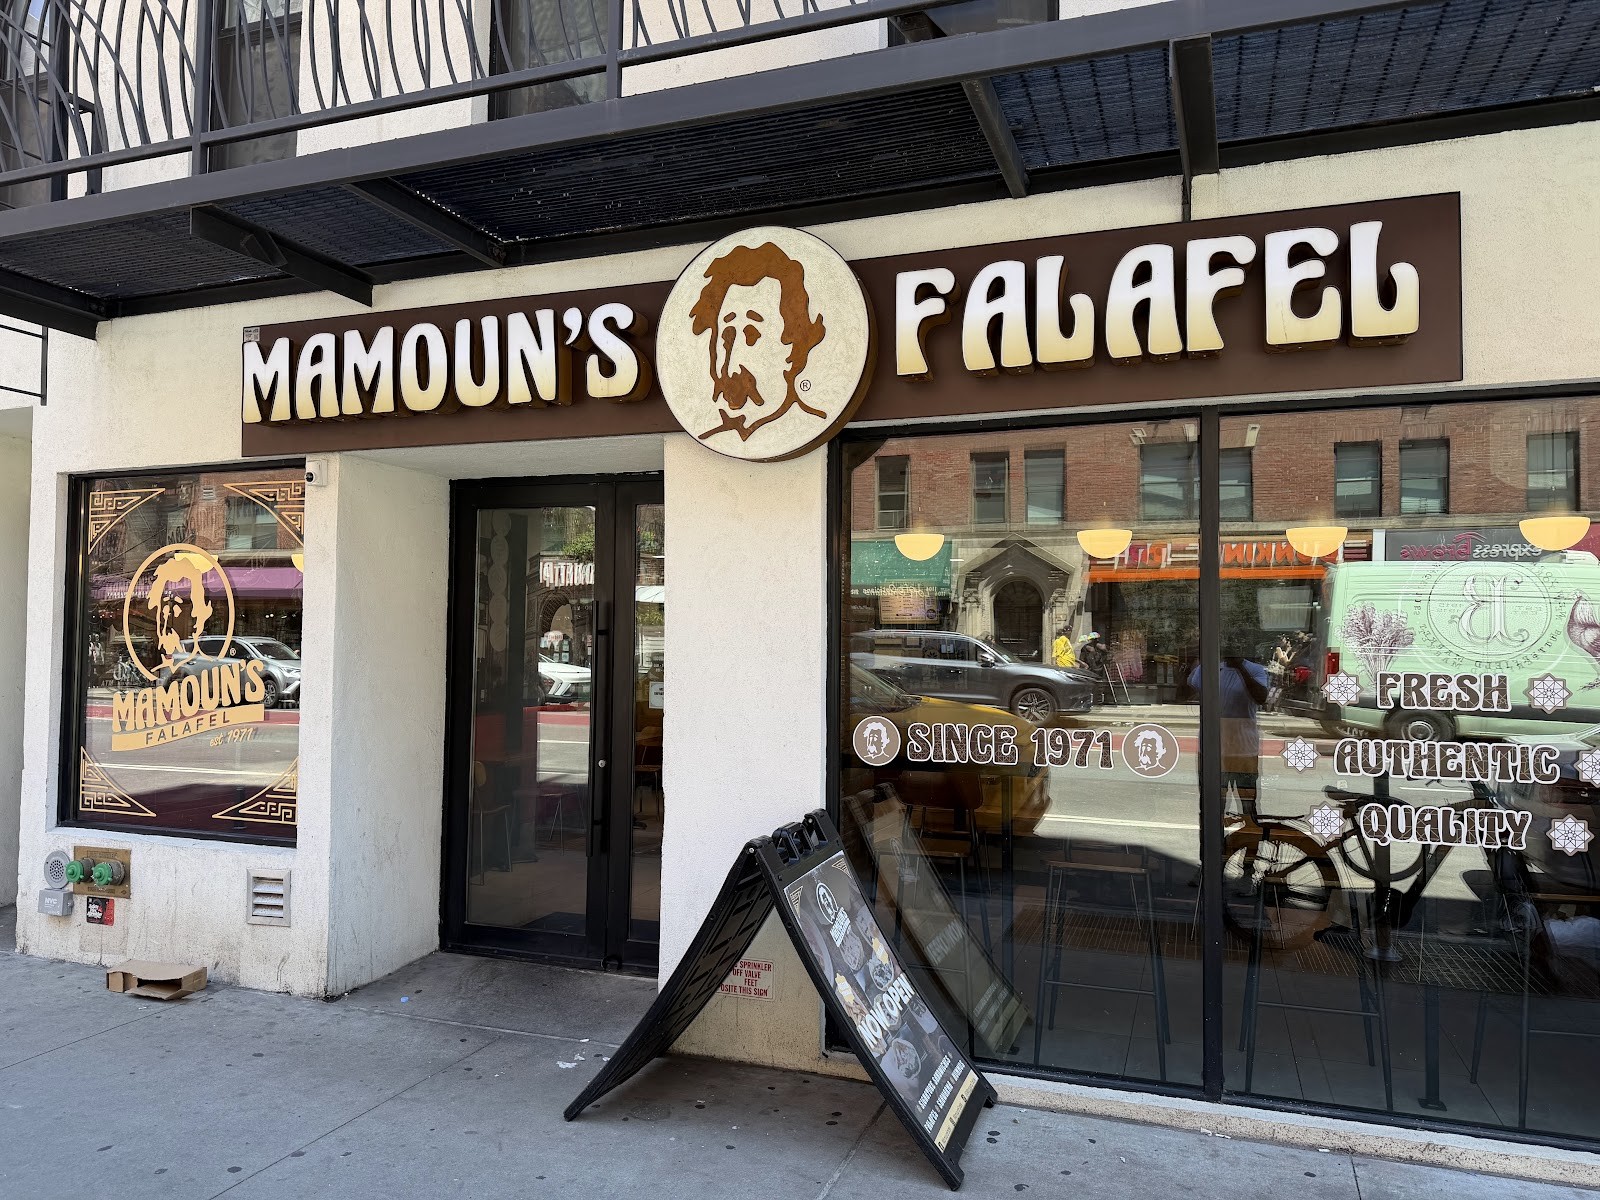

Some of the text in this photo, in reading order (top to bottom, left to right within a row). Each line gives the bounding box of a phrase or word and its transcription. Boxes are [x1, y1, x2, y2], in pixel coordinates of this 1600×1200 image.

[242, 221, 1420, 424] MAMOUN'S FALAFEL
[112, 659, 265, 732] MAMOUN'S
[1376, 671, 1513, 712] FRESH
[145, 711, 230, 745] FALAFEL
[210, 729, 253, 747] est 1971
[906, 722, 1114, 770] SINCE 1971
[1334, 738, 1560, 784] AUTHENTIC
[1360, 804, 1532, 850] QUALITY
[740, 961, 772, 972] SPRINKLER
[745, 970, 761, 979] VALVE
[720, 983, 768, 997] OSITE THIS SIGN
[857, 973, 915, 1049] NOW OPEN
